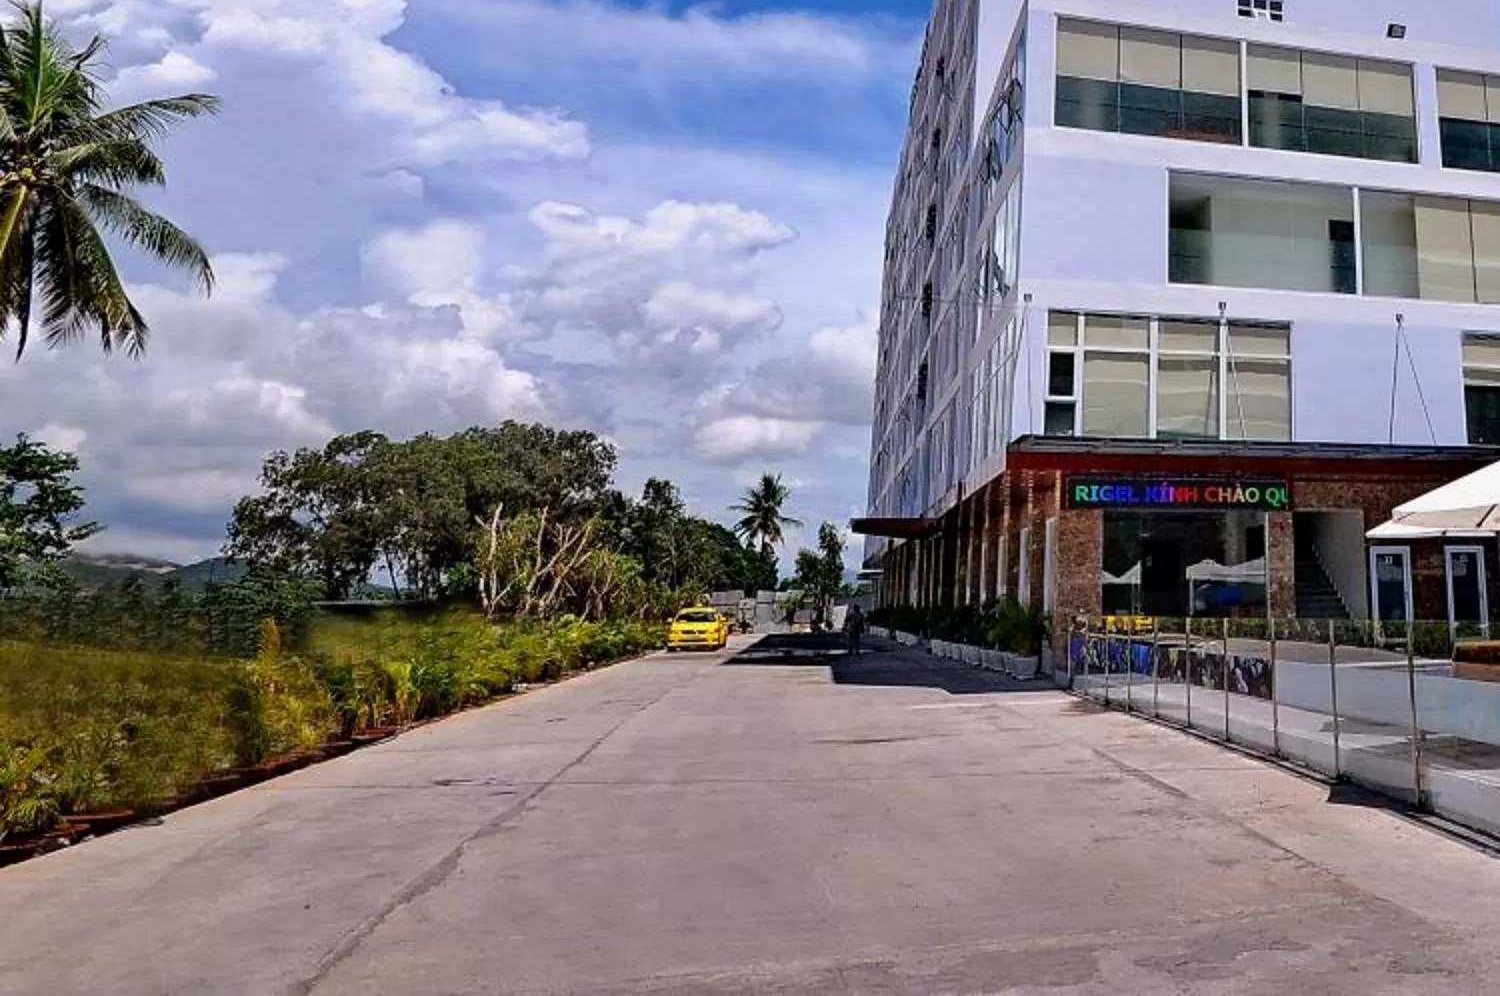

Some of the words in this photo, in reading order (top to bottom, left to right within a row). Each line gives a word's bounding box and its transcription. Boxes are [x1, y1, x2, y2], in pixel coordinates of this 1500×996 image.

[1075, 485, 1140, 502] RIGEL
[1146, 482, 1198, 503] KÍNH
[1204, 483, 1260, 503] CHÀO
